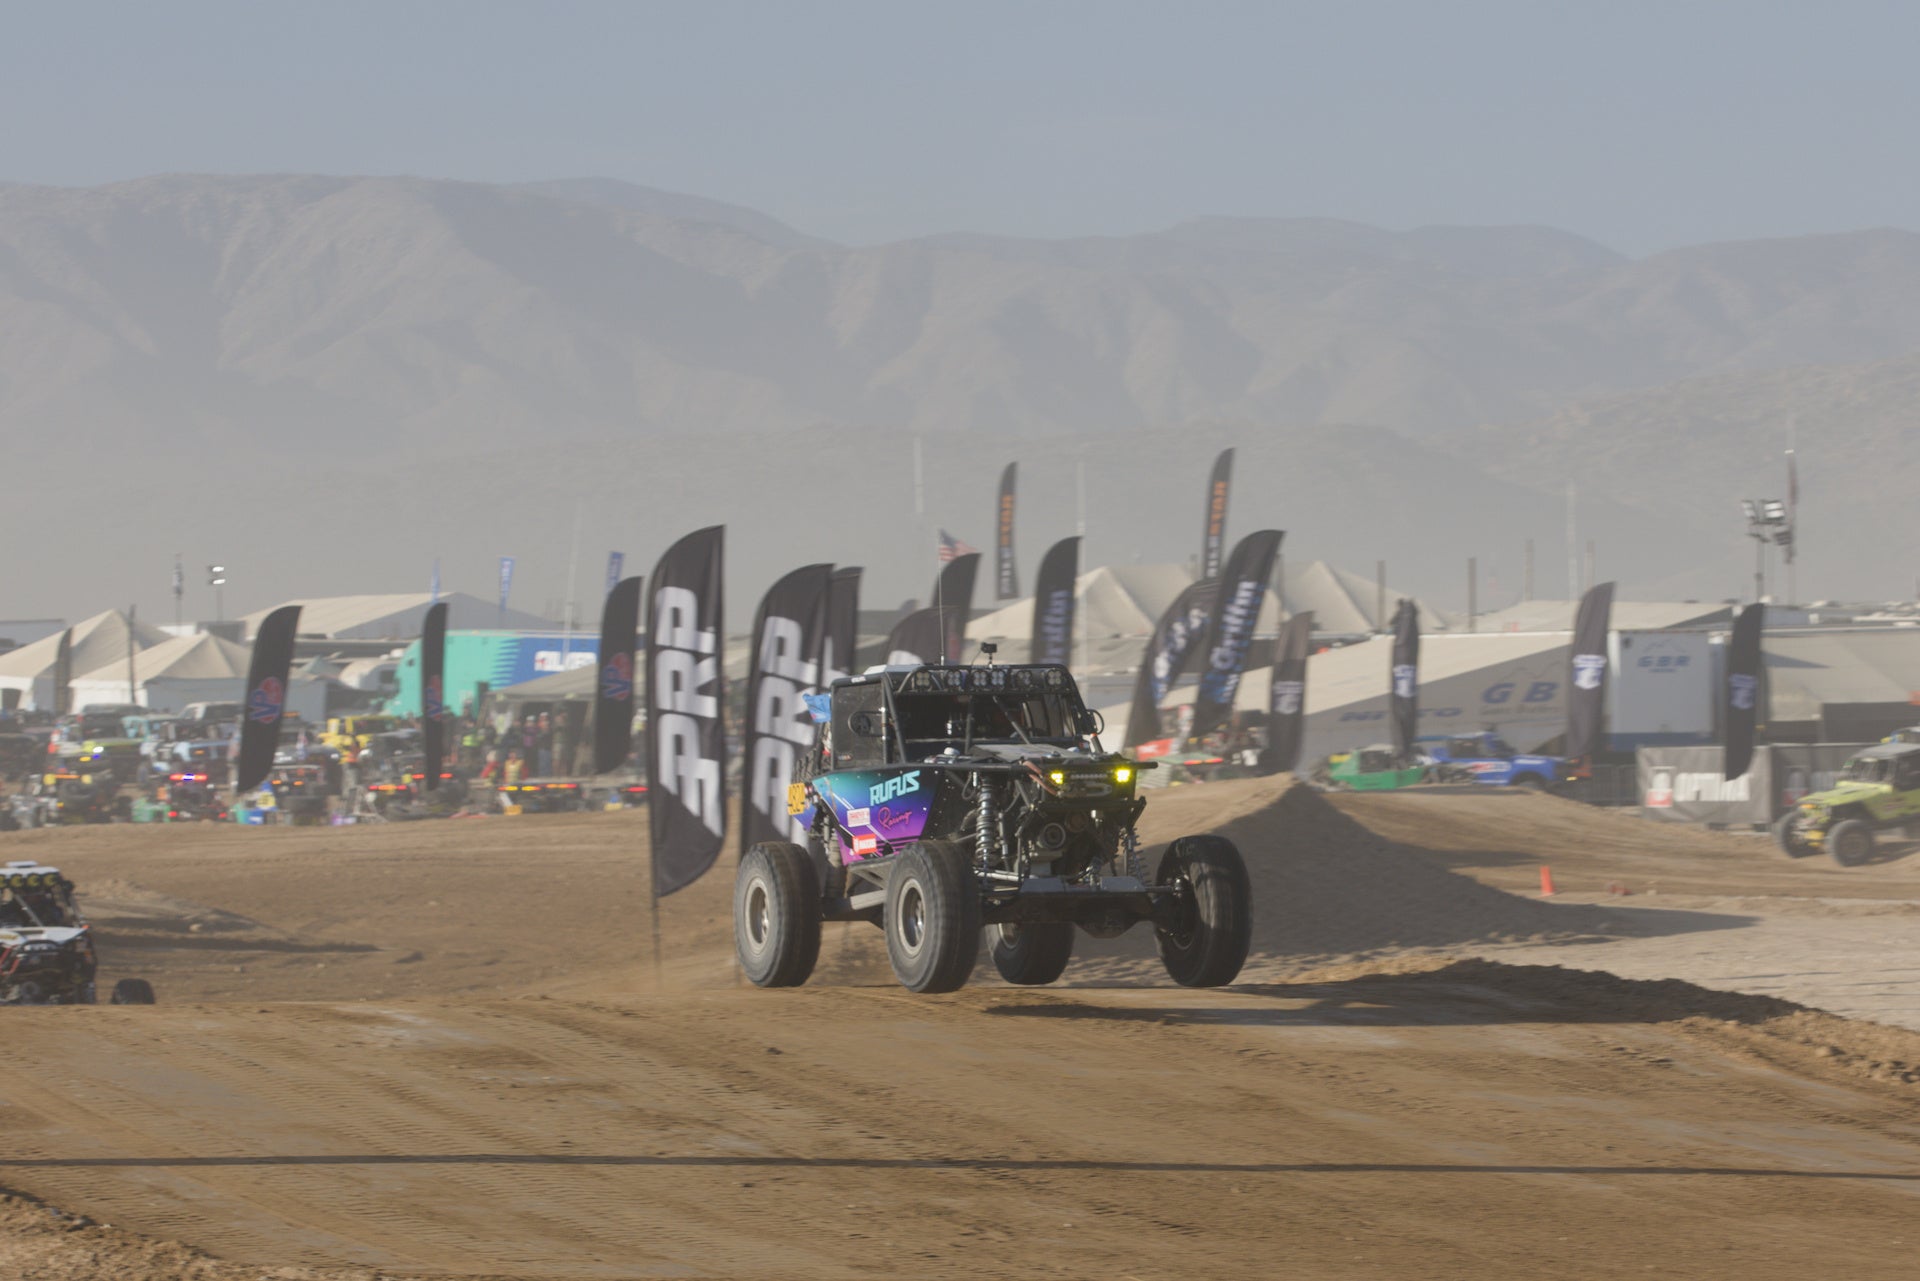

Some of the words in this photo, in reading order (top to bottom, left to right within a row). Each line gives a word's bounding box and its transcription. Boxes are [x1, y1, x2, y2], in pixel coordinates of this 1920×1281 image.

[655, 586, 723, 838] PRP
[869, 769, 920, 806] RUFUS
[877, 806, 912, 830] Racing
